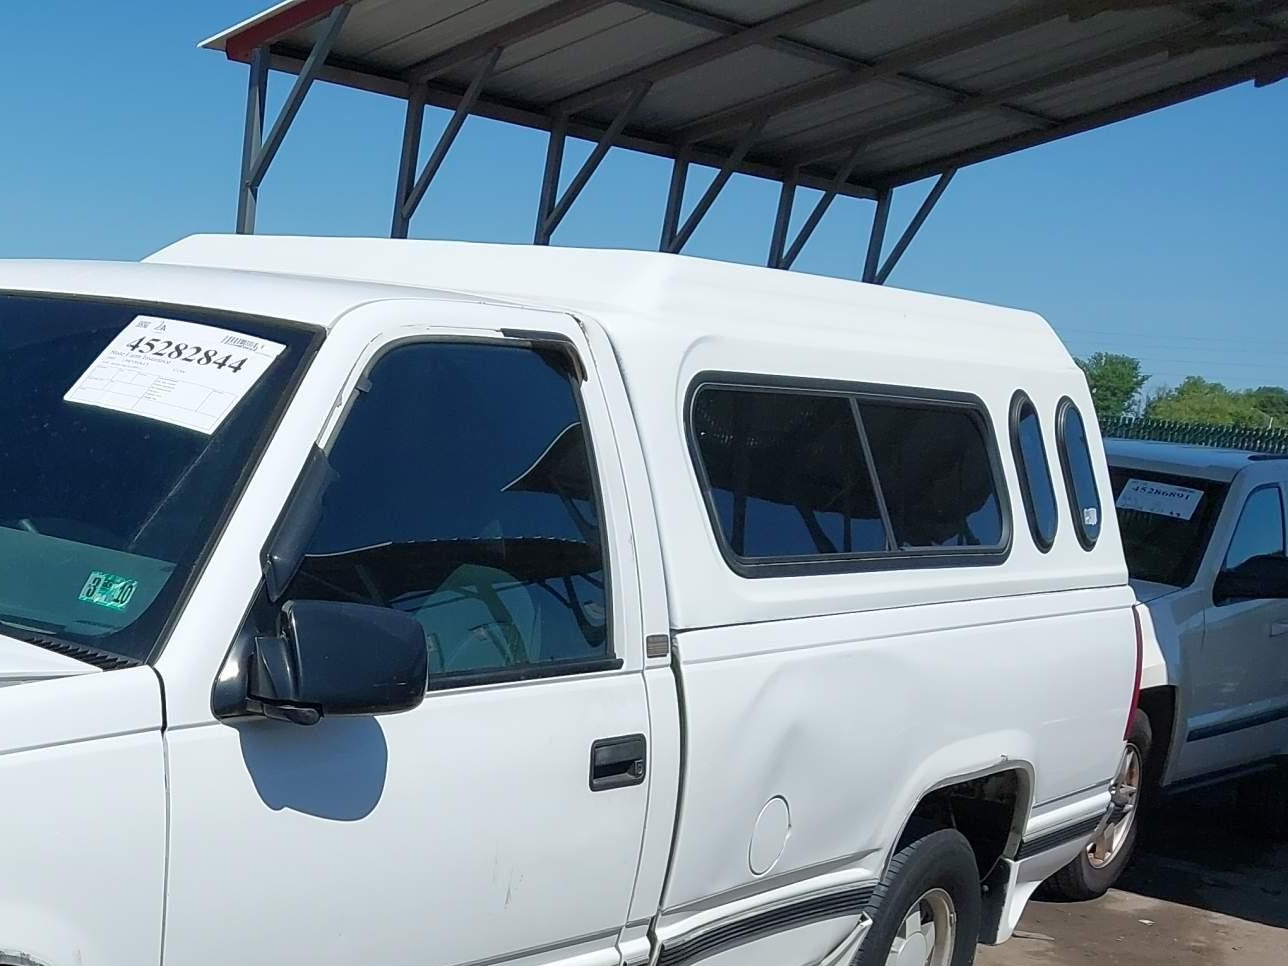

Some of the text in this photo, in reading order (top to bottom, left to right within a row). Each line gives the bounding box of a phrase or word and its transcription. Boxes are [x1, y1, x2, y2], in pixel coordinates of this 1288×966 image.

[125, 335, 249, 374] 45282844
[1131, 484, 1191, 501] 45286891
[112, 581, 134, 605] 10
